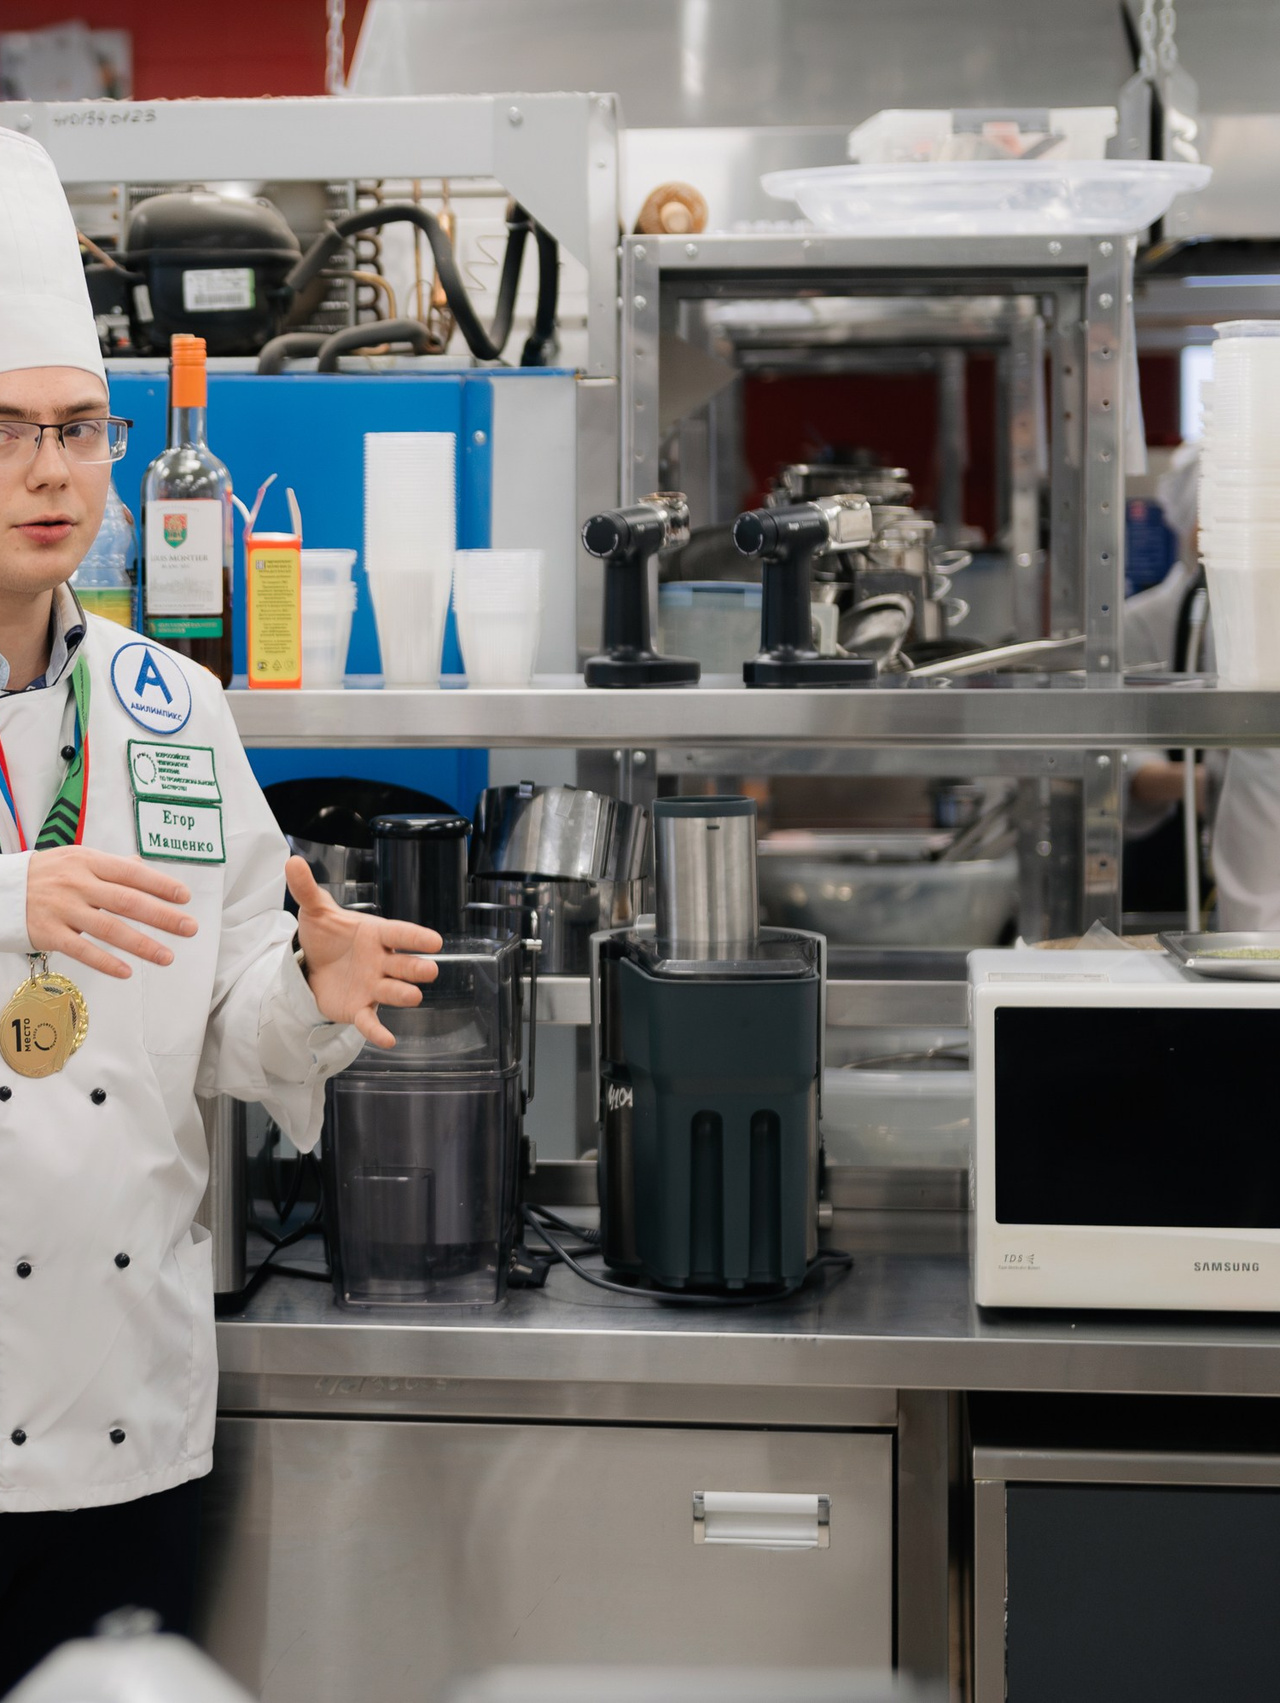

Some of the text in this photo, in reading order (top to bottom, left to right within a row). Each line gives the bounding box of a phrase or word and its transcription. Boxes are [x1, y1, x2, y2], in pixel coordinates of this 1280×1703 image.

[130, 702, 183, 722] АБИЛИМПИКС
[162, 809, 195, 830] Егор
[148, 832, 214, 853] Мащенко
[11, 1018, 22, 1052] 1
[1193, 1262, 1260, 1272] SAMSUNG
